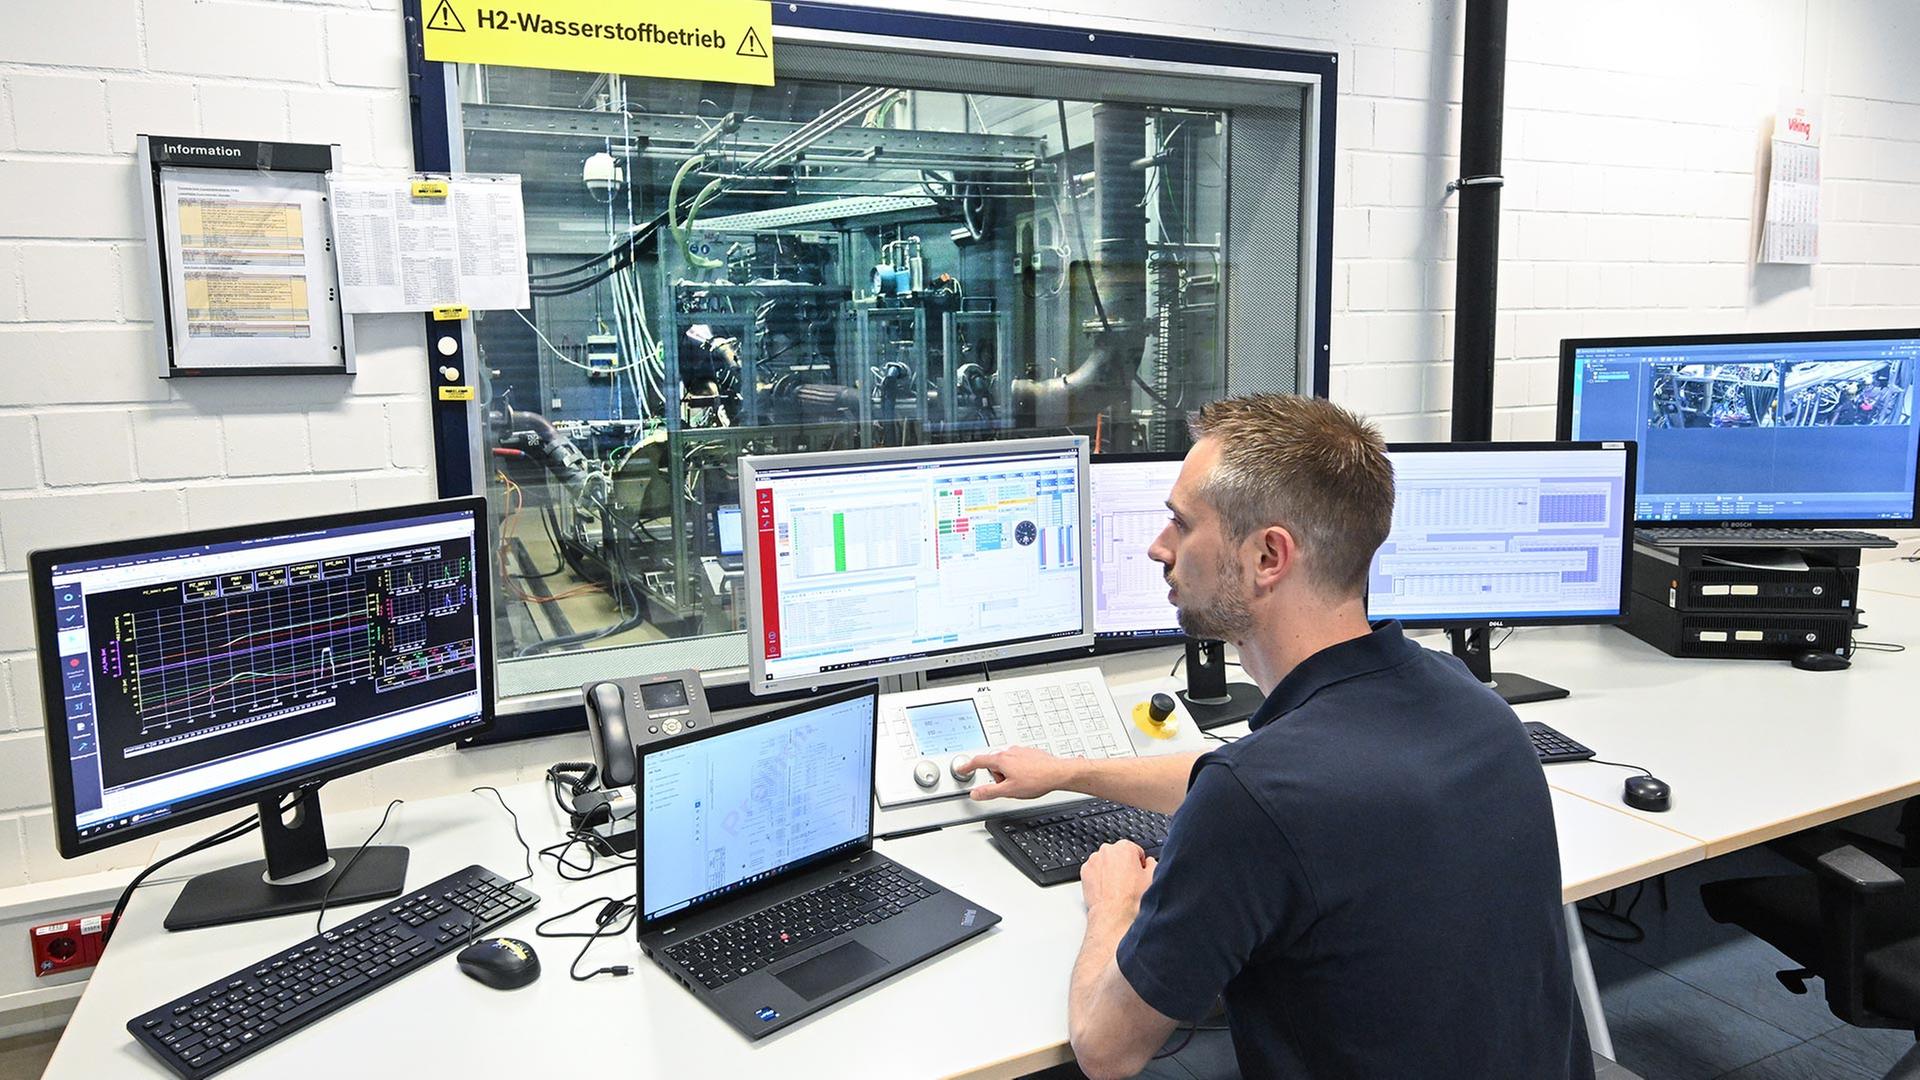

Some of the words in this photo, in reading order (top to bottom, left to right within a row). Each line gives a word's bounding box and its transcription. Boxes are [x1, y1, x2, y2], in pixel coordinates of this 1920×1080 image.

[477, 8, 726, 49] H2-Wasserstoffbetrieb
[1788, 117, 1811, 141] Viking
[163, 143, 242, 157] Information
